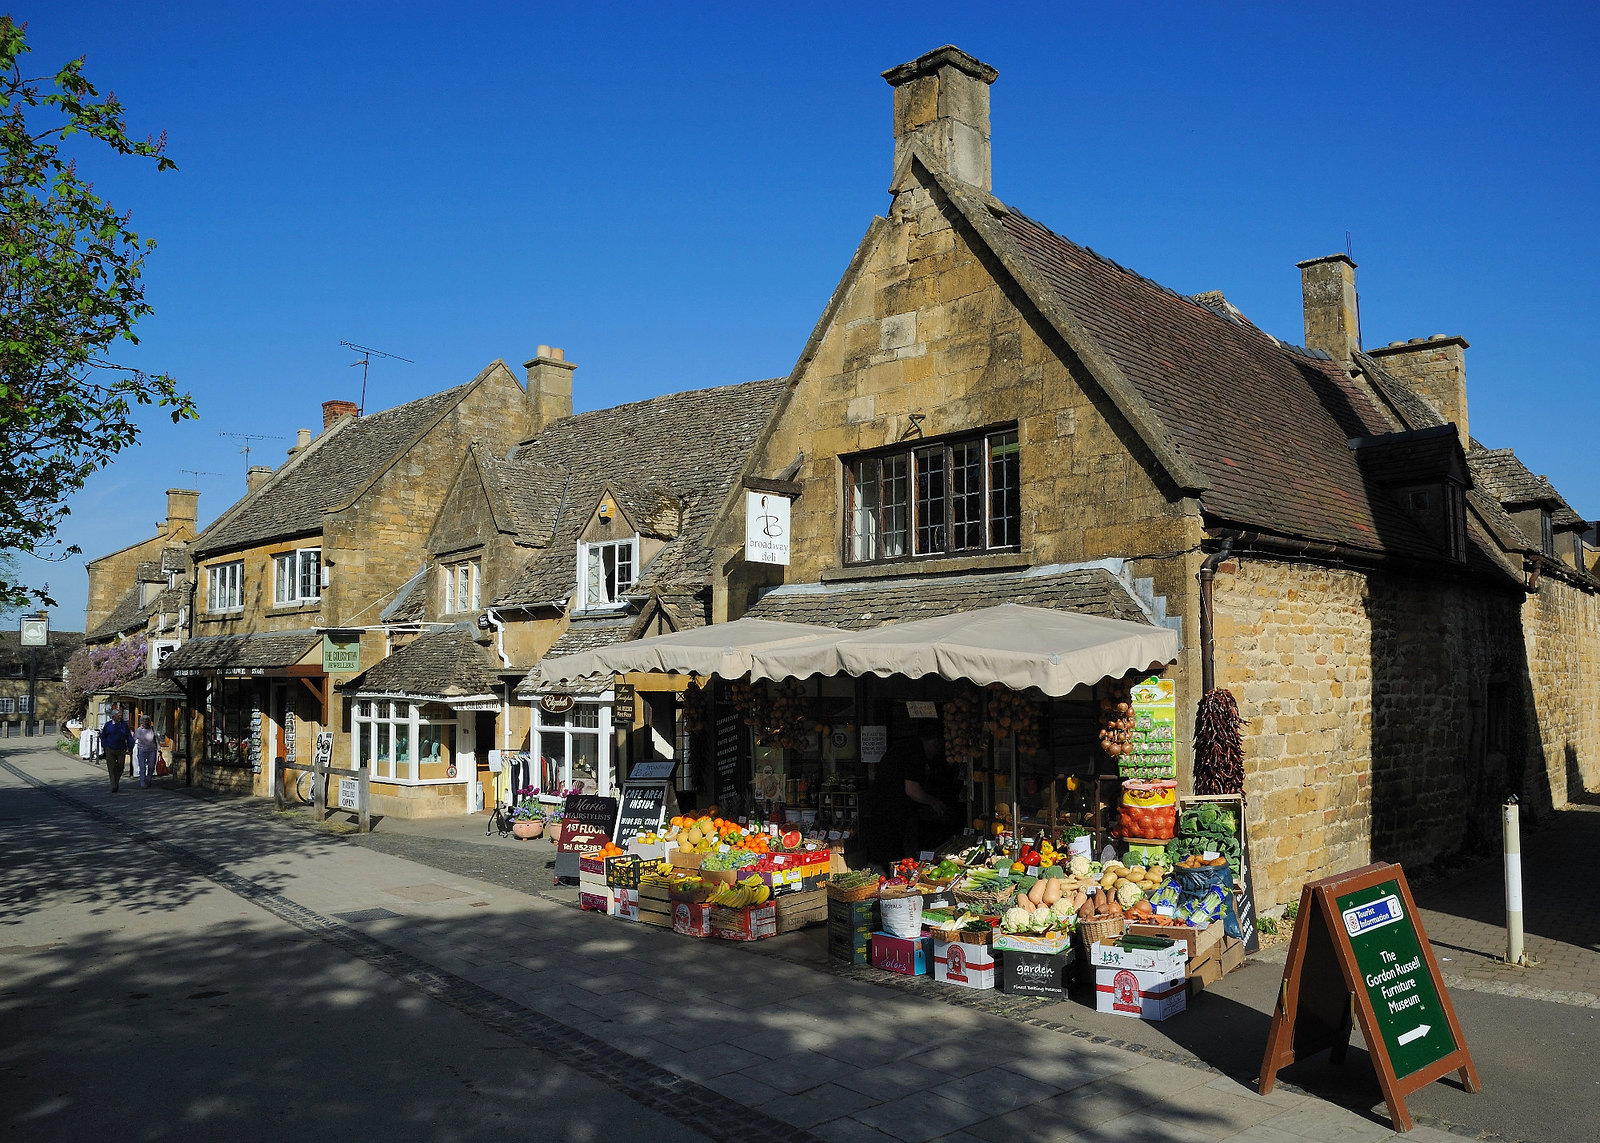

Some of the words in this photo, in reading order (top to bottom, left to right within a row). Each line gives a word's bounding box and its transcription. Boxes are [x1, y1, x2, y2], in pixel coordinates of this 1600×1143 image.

[749, 537, 789, 554] broadway
[761, 552, 777, 562] deli
[625, 789, 643, 799] CAFE
[643, 789, 663, 799] AREA
[342, 798, 355, 807] OPEN
[629, 799, 655, 809] INSIDE
[566, 812, 611, 820] HAIRSTYLISTS
[621, 817, 634, 825] WIDE
[634, 818, 659, 826] SELCTION
[580, 824, 605, 834] FLOOR
[574, 844, 602, 852] 852383
[1356, 907, 1375, 919] Tourist
[1359, 913, 1390, 929] Information
[1380, 950, 1397, 964] The
[1016, 964, 1055, 975] garden
[1366, 969, 1396, 988] Gordon
[1396, 955, 1421, 975] Russell
[1027, 985, 1044, 993] Baking
[1381, 978, 1417, 999] Furniture
[1388, 993, 1421, 1014] Museum
